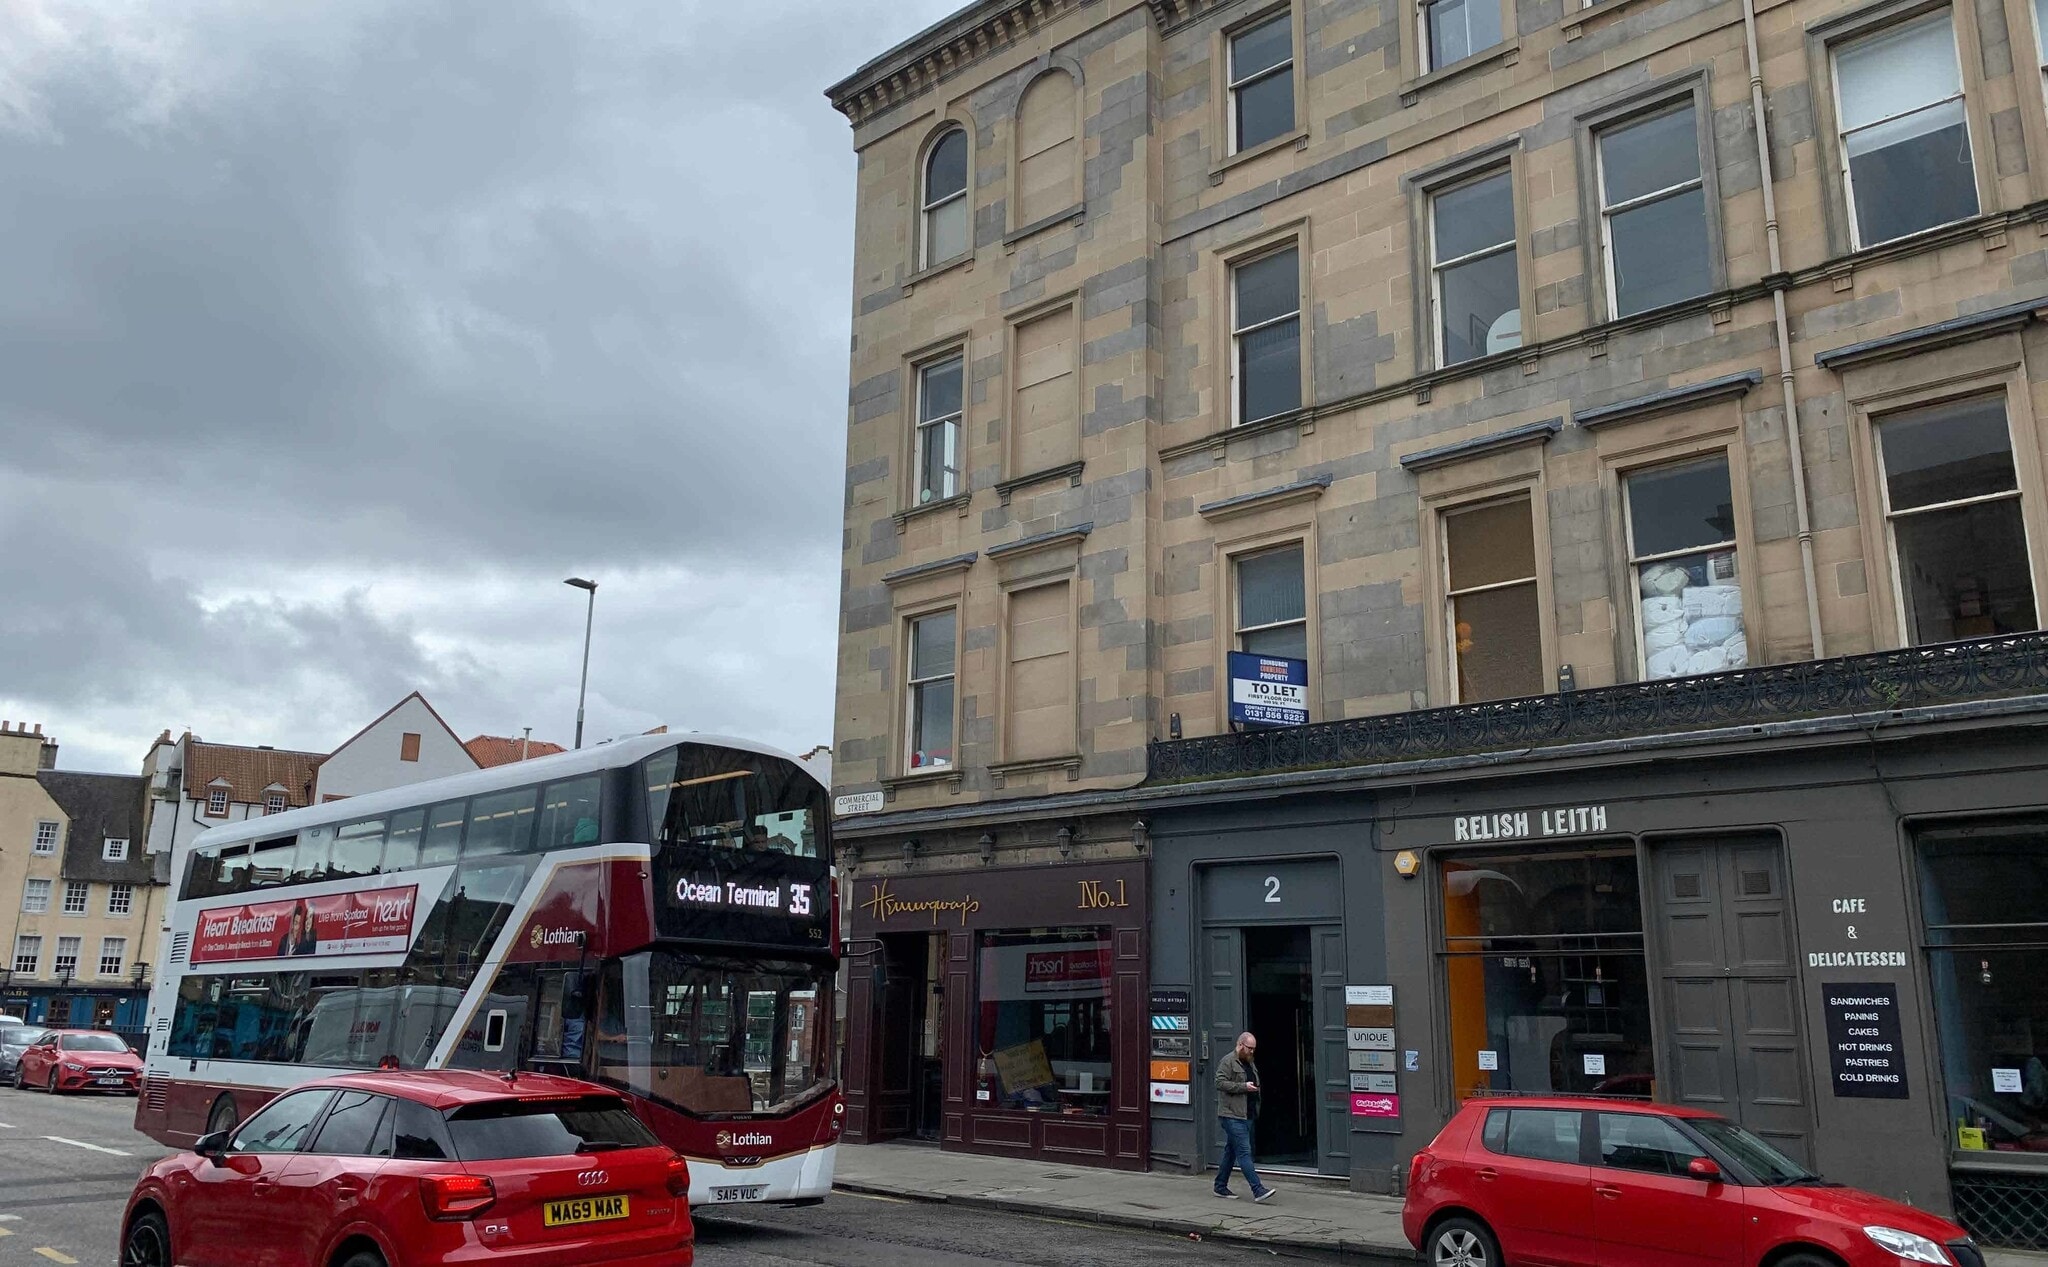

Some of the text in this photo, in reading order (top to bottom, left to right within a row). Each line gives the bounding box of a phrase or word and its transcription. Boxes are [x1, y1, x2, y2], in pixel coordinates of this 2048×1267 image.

[1260, 673, 1288, 681] PROPERTY
[1252, 683, 1297, 697] TO LET
[1245, 710, 1263, 718] 0131
[1284, 713, 1305, 722] 6222
[839, 793, 879, 805] COMMERCIAL
[848, 803, 869, 812] STREET
[1455, 806, 1607, 841] RELISH LEITH
[1264, 876, 1281, 903] 2
[676, 878, 811, 915] Ocean Terminal 35
[373, 892, 411, 923] heart
[1833, 898, 1866, 913] CAFE
[318, 907, 369, 923] Live from Scotland
[203, 912, 278, 938] Heart Breakfast
[808, 928, 823, 939] 552
[1847, 925, 1858, 939] &
[1808, 951, 1906, 967] DELICATESSEN
[1830, 997, 1890, 1006] SANDWICHES
[1844, 1012, 1879, 1021] PANINIS
[1354, 1033, 1388, 1042] UNIQUE
[1848, 1028, 1879, 1036] CAKES
[1838, 1043, 1893, 1052] HOT DRINKS
[1845, 1058, 1889, 1067] PASTRIES
[1839, 1073, 1899, 1083] COLD DRINKS
[732, 1132, 772, 1146] Lothian
[717, 1187, 758, 1201] SA15 VUC
[551, 1198, 623, 1222] MA69 MAR
[485, 1224, 508, 1235] Q2
